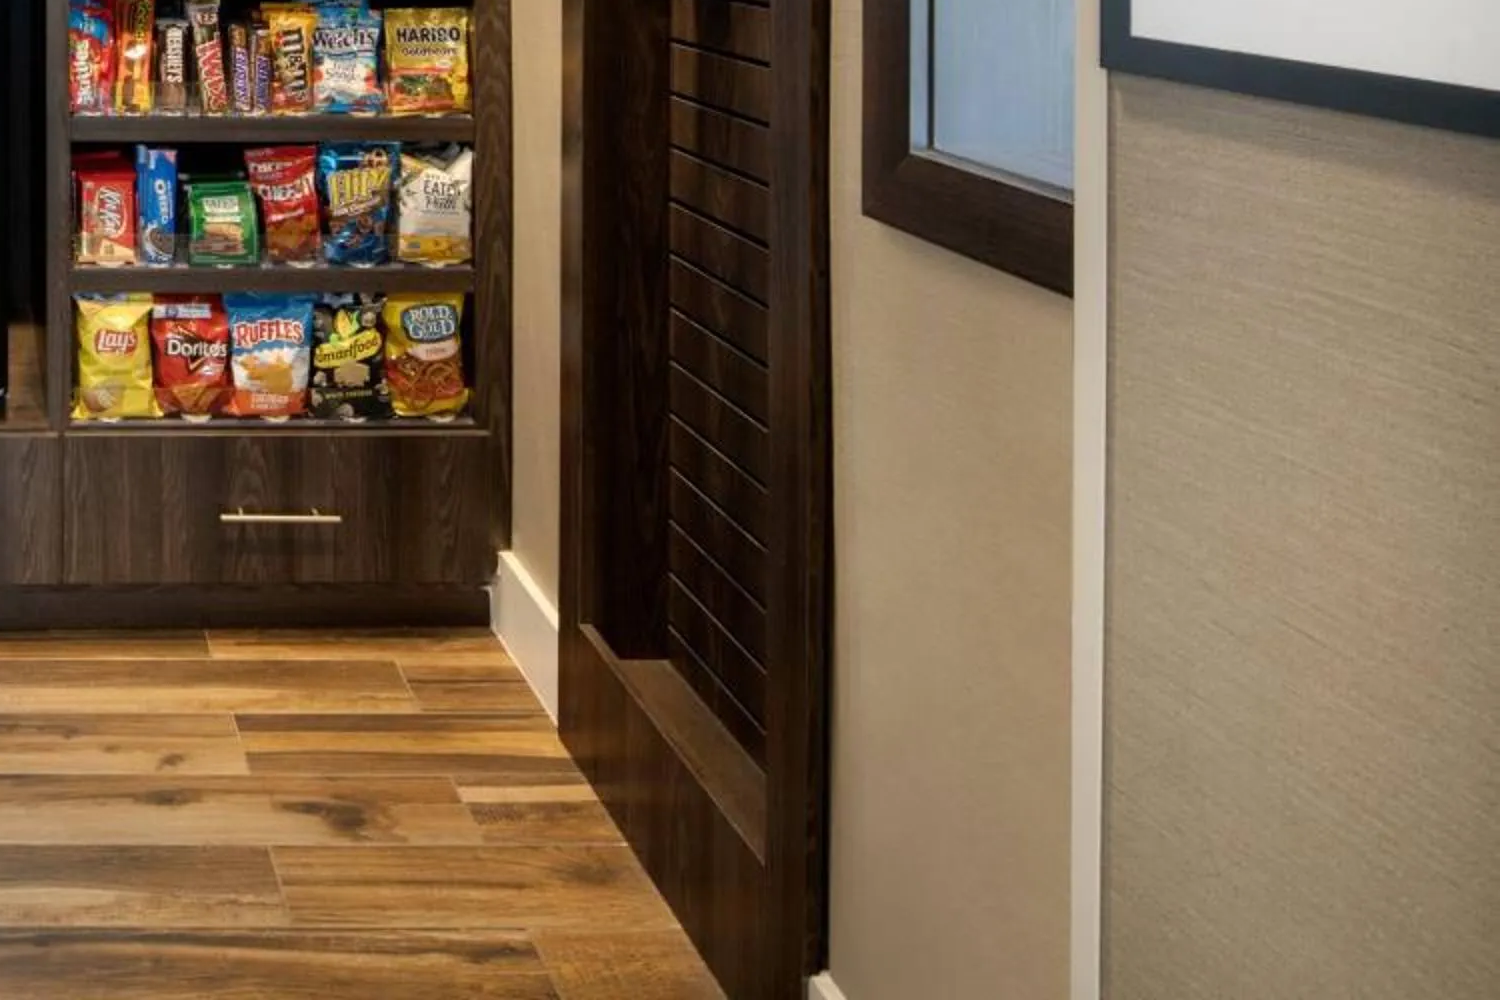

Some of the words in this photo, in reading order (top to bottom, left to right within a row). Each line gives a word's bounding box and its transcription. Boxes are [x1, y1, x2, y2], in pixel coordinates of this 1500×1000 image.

[395, 27, 461, 48] HARIBO
[97, 331, 136, 352] Lay's
[235, 320, 304, 349] RUFFLES
[166, 338, 228, 357] Doritos
